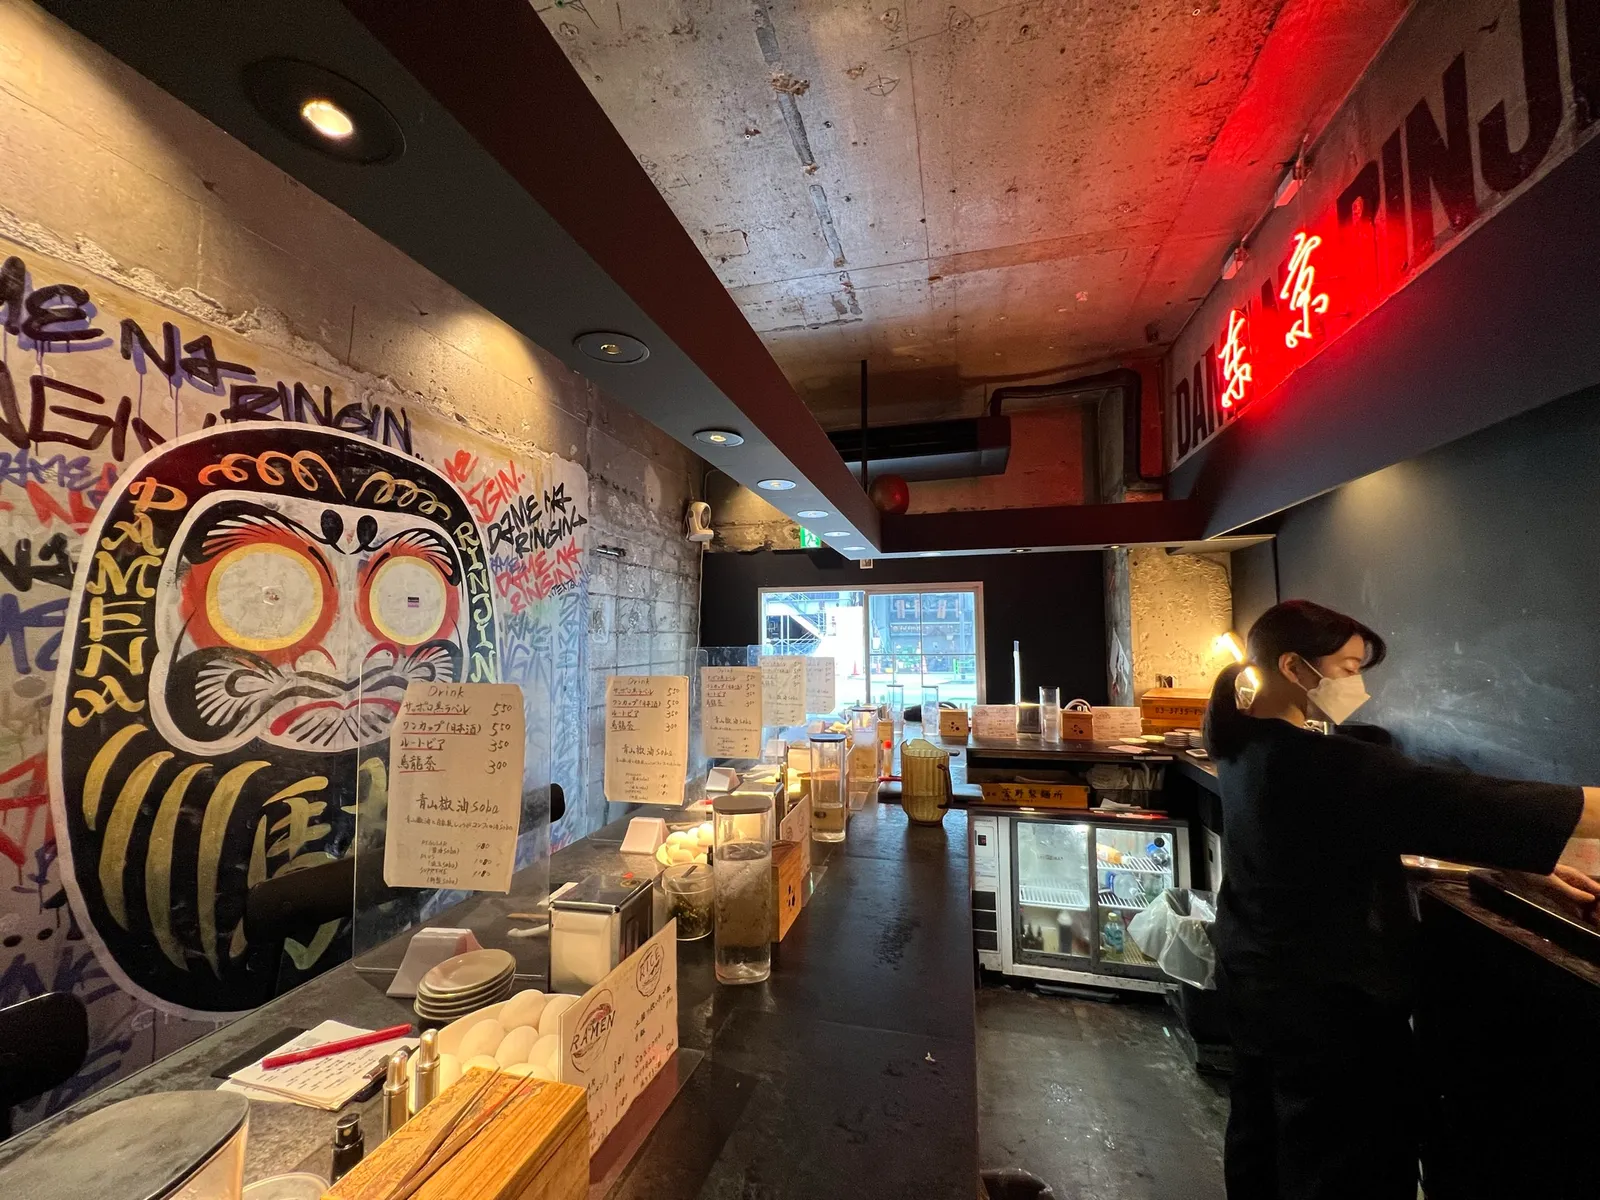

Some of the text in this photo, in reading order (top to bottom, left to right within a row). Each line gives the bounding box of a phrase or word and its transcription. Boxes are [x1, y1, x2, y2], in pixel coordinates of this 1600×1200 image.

[452, 521, 499, 684] RINJIN
[428, 686, 464, 698] Drink
[492, 702, 513, 716] 550
[489, 723, 511, 737] 550
[488, 739, 509, 752] 350
[485, 760, 507, 774] 300
[639, 946, 661, 982] RICE
[569, 1009, 616, 1052] RAMEN
